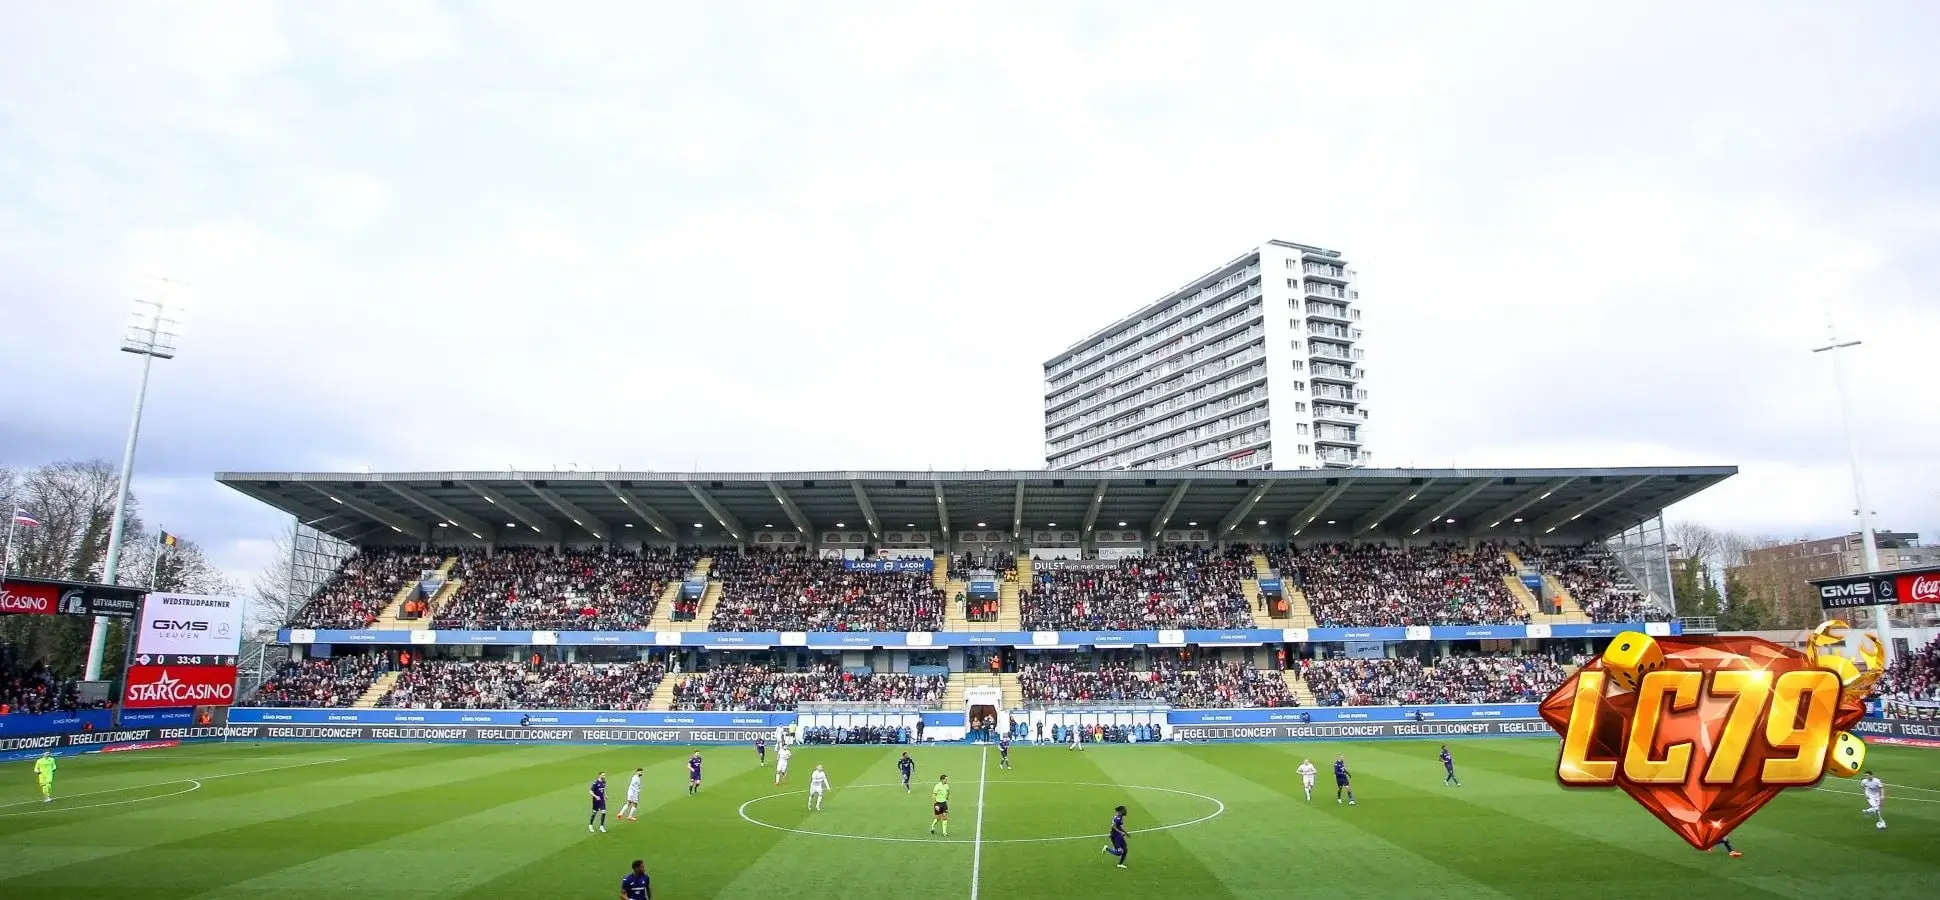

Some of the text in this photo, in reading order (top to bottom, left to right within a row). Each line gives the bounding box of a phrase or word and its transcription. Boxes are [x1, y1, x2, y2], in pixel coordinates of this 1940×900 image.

[1034, 562, 1064, 570] DULST
[1821, 582, 1872, 598] GMS
[4, 595, 48, 610] CASINO
[1830, 598, 1864, 606] LEUVEN
[152, 620, 208, 631] GMS
[157, 655, 219, 664] 0 33:43 1
[160, 727, 258, 738] TEGEL CONCEPT
[1286, 726, 1384, 737] TEGEL CONCEPT
[1393, 724, 1490, 734] TEGEL CONCEPT
[1498, 723, 1528, 732] TEGEL
[1857, 722, 1892, 733] CONCEPT
[1900, 724, 1929, 735] TEGEL
[68, 730, 150, 744] TEGEL CONCEPT
[268, 728, 362, 738] TEGEL CONCEPT
[371, 728, 468, 738] TEGEL CONCEPT
[476, 730, 573, 740] TEGEL CONCEPT
[582, 730, 680, 740] TEGEL CONCEPT
[689, 731, 788, 741] TEGEL CONCET
[1180, 728, 1277, 738] TEGEL CONCEPT
[19, 735, 61, 749] CONCEPT
